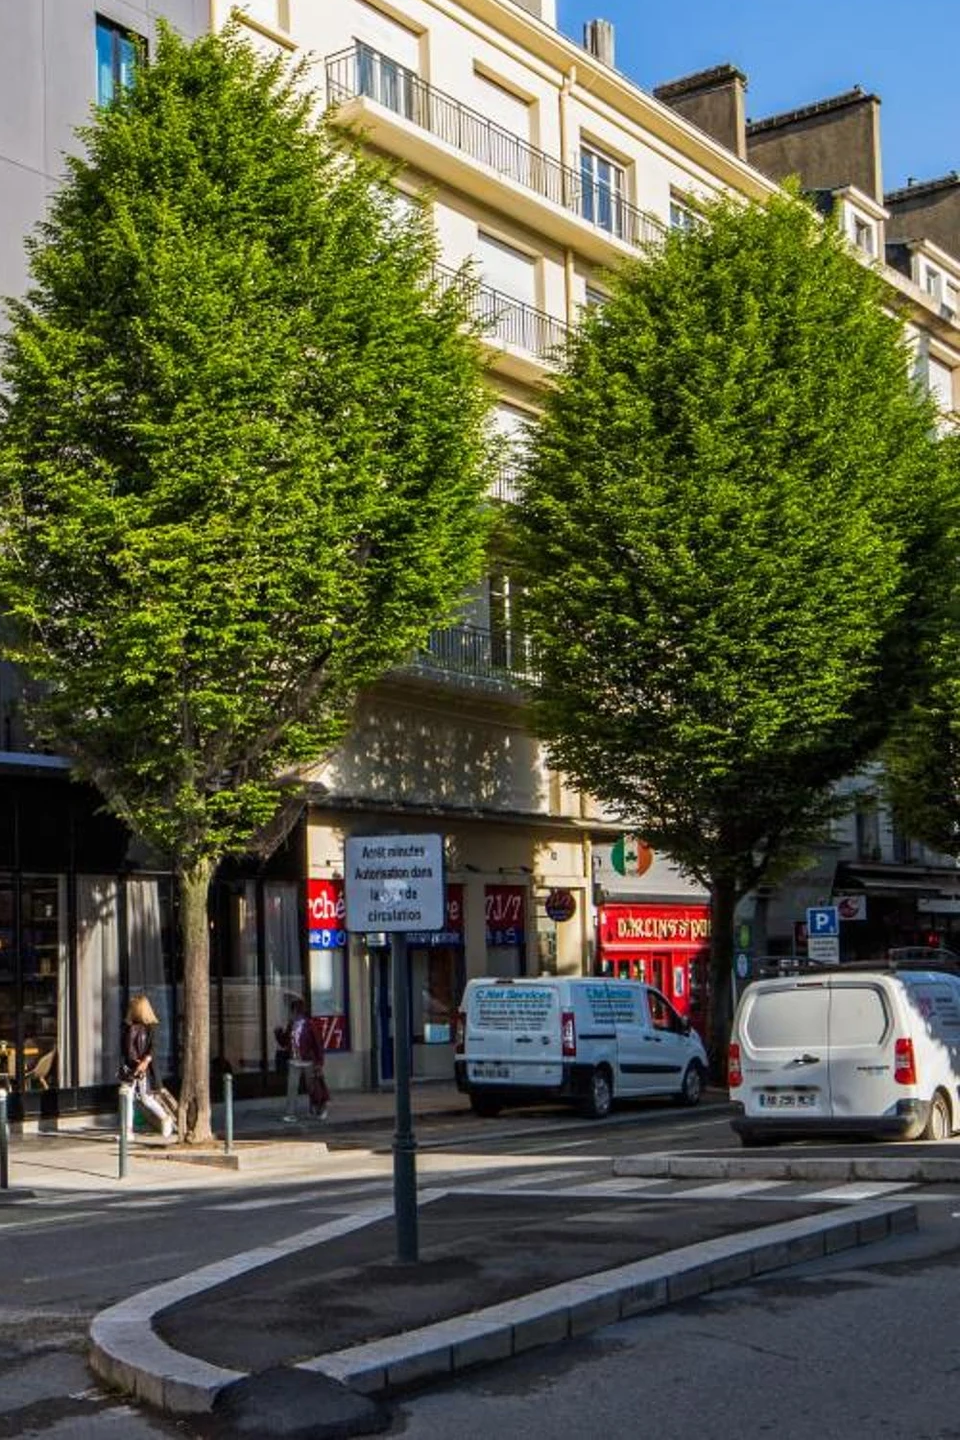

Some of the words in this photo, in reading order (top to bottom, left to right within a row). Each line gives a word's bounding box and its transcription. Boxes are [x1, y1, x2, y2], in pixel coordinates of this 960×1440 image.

[387, 845, 425, 858] minutes
[355, 868, 409, 880] Autorisation
[411, 866, 433, 879] dans
[405, 886, 418, 900] de
[368, 910, 421, 922] circulation
[816, 914, 829, 930] P
